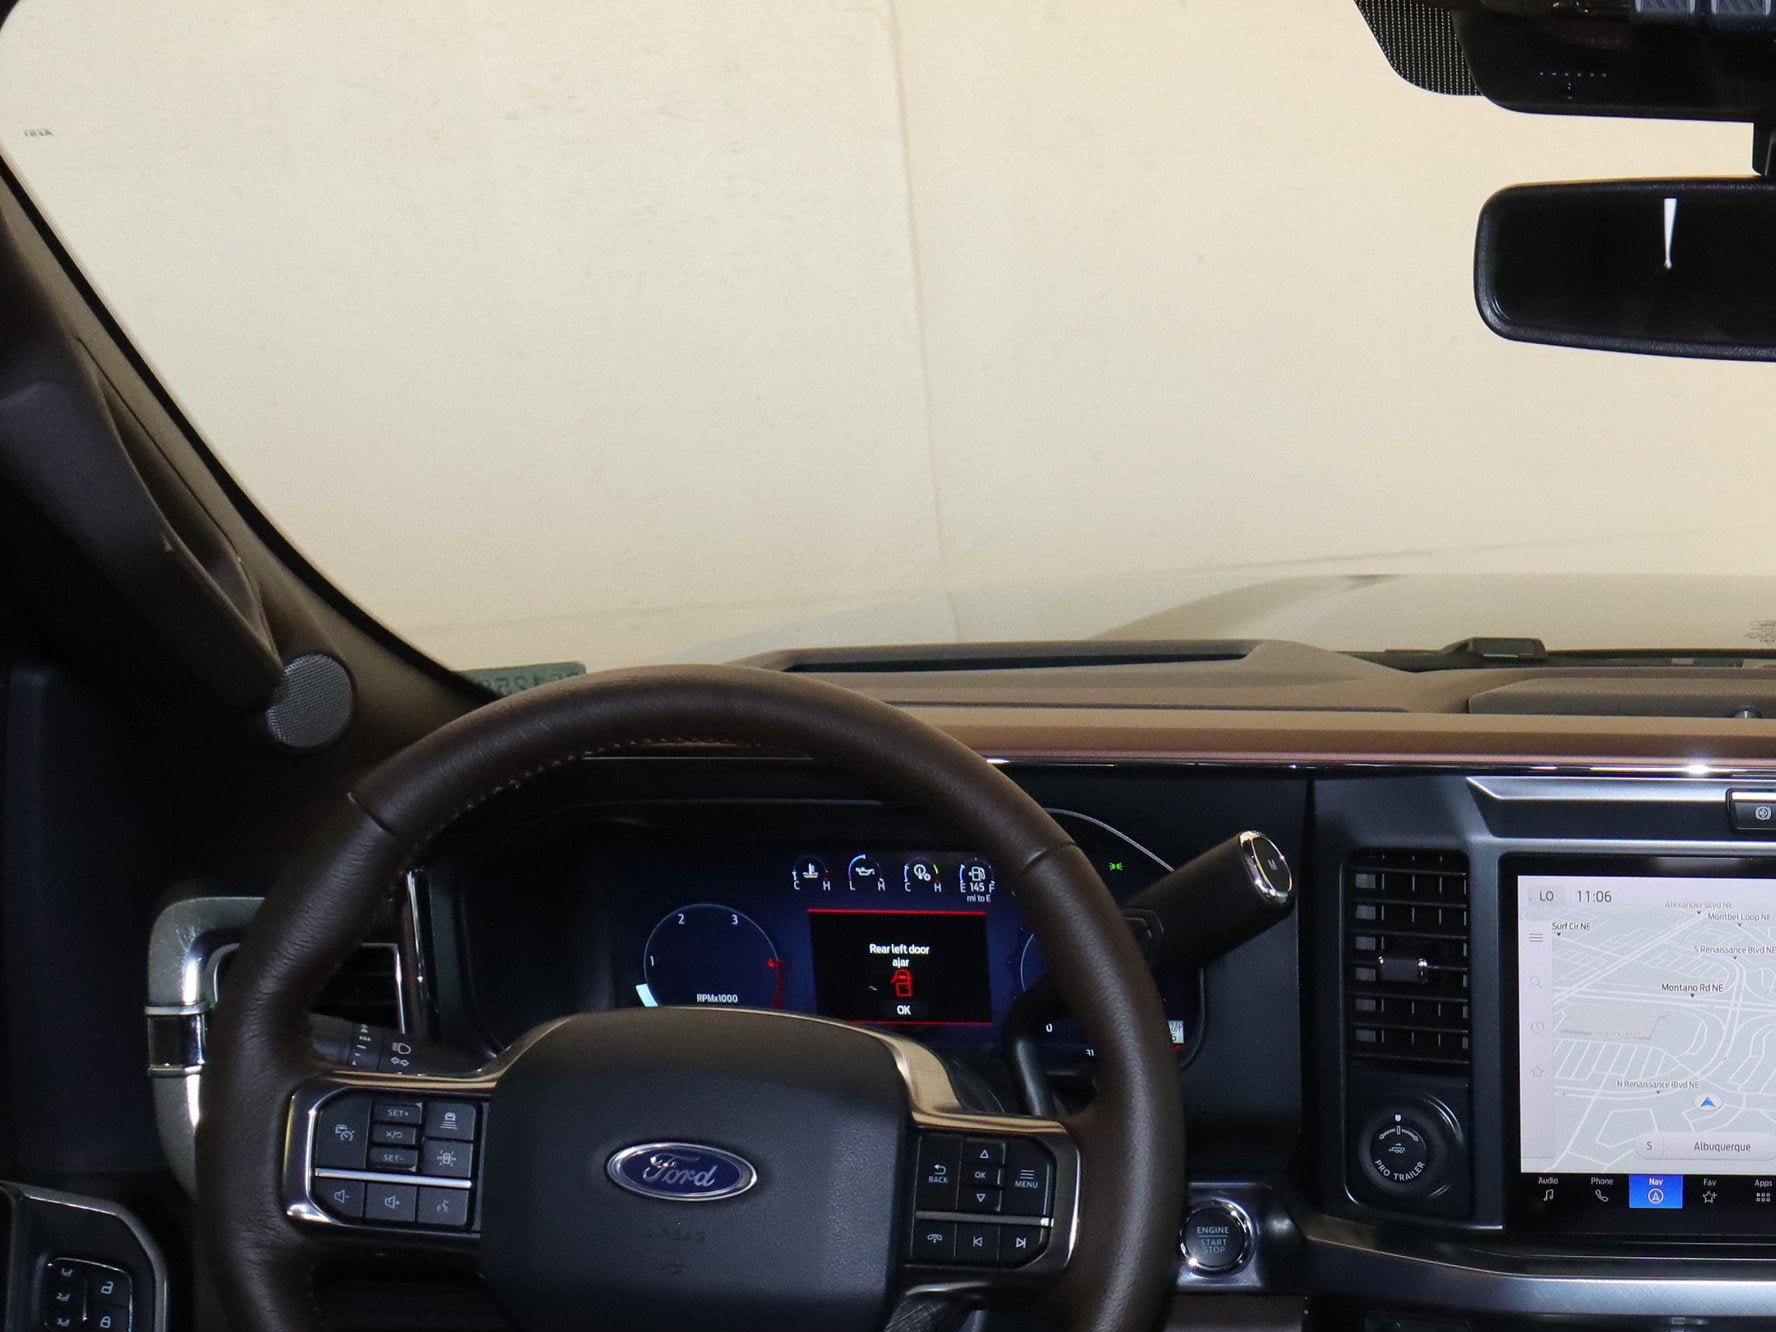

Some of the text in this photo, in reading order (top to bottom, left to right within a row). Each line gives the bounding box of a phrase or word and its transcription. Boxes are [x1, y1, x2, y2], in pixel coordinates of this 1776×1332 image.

[793, 880, 801, 891] C
[823, 880, 831, 891] H
[849, 880, 856, 891] L
[877, 881, 886, 891] H
[904, 882, 912, 892] C
[934, 882, 942, 893] H
[960, 882, 967, 893] E
[969, 882, 985, 892] 145
[989, 882, 996, 893] F
[966, 895, 976, 903] mi
[986, 894, 992, 903] E
[1539, 890, 1555, 902] LO
[1576, 890, 1612, 903] 11:06
[1664, 900, 1703, 909] Alexander
[1704, 901, 1721, 909] Blvd
[677, 913, 686, 925] 2
[731, 914, 739, 925] 3
[1707, 912, 1740, 921] Montbel
[1741, 913, 1760, 922] Loop
[1552, 922, 1591, 931] Surf Cir NE
[868, 943, 930, 954] Rear left door
[1693, 945, 1776, 954] S Renaissance Blvd NE
[649, 955, 655, 967] 1
[891, 956, 910, 969] ajar
[1661, 983, 1724, 992] Montano Rd NE
[696, 993, 739, 1003] RPMx1000
[896, 1004, 912, 1015] OK
[1045, 1022, 1053, 1033] 0
[1616, 1080, 1700, 1089] N Renaissance Blvd NE
[387, 1108, 410, 1117] SET+
[1646, 1141, 1653, 1150] S
[1693, 1141, 1752, 1153] Albuquerque
[641, 1152, 719, 1187] Ford
[1374, 1158, 1426, 1181] PRO TRAILER
[928, 1176, 949, 1184] BACK
[974, 1171, 986, 1179] OK
[1014, 1180, 1039, 1189] MENU
[1537, 1176, 1559, 1185] Audio
[1590, 1177, 1614, 1186] Phone
[1648, 1177, 1664, 1186] Nav
[1703, 1178, 1717, 1187] Fav
[1754, 1179, 1773, 1188] Apps
[1196, 1226, 1230, 1234] ENGINE
[1200, 1238, 1227, 1247] START
[1202, 1246, 1226, 1254] STOP
